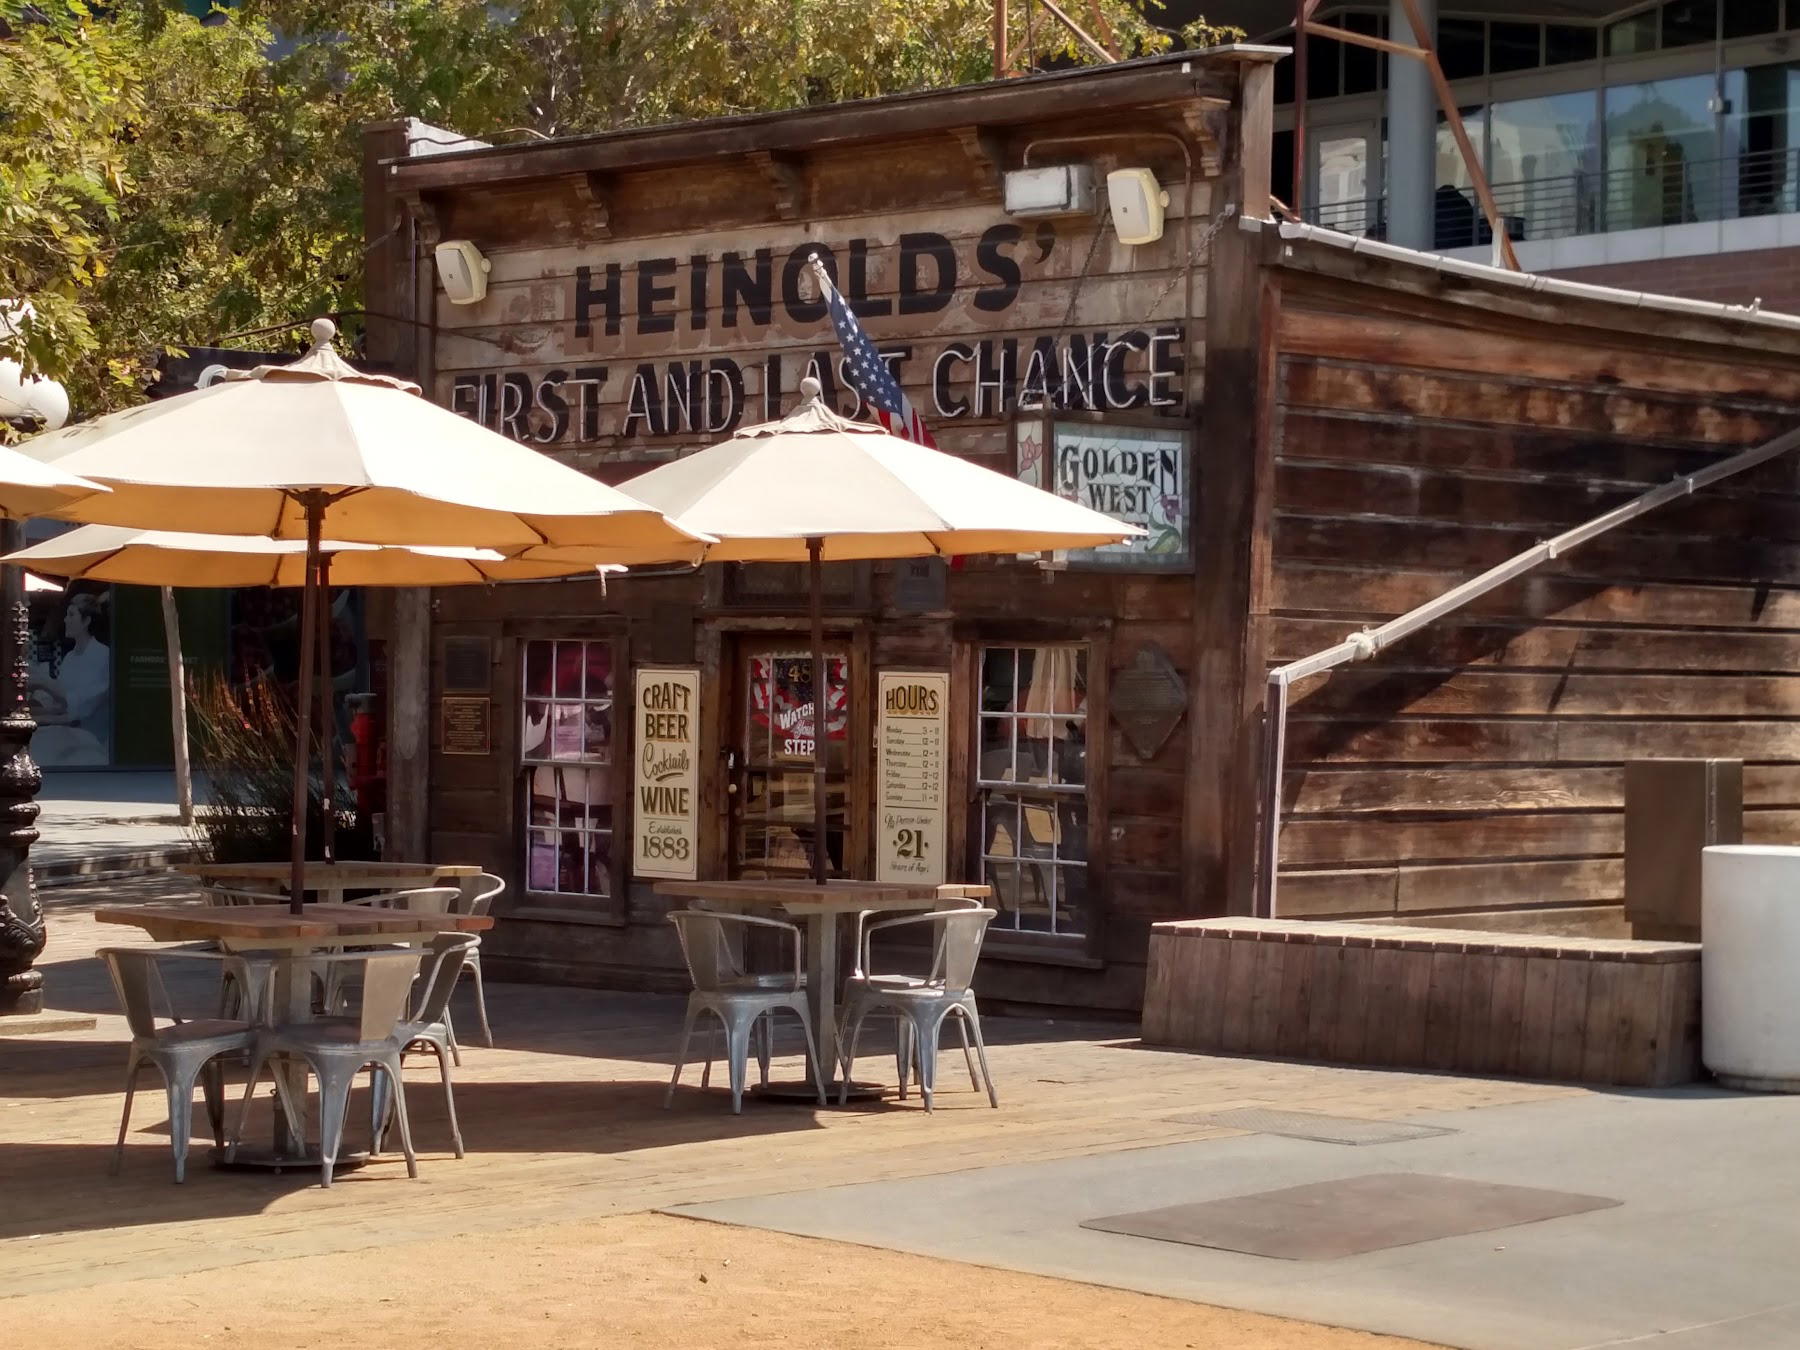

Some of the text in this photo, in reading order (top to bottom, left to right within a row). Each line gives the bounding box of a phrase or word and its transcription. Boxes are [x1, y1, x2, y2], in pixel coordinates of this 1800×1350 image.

[575, 221, 1056, 338] HEINOLDS'
[452, 366, 608, 443] FIRST
[622, 357, 746, 438] AND
[933, 327, 1185, 418] CHANCE
[1060, 444, 1177, 495] GOLDEN
[1088, 484, 1151, 513] WEST
[642, 682, 691, 712] CRAFT
[886, 685, 938, 713] HOURS
[645, 713, 689, 740] BEER
[780, 702, 815, 730] WATCH
[642, 743, 689, 779] Cocktails
[784, 739, 815, 756] STEP
[640, 786, 689, 814] WINE
[643, 835, 689, 861] 1883
